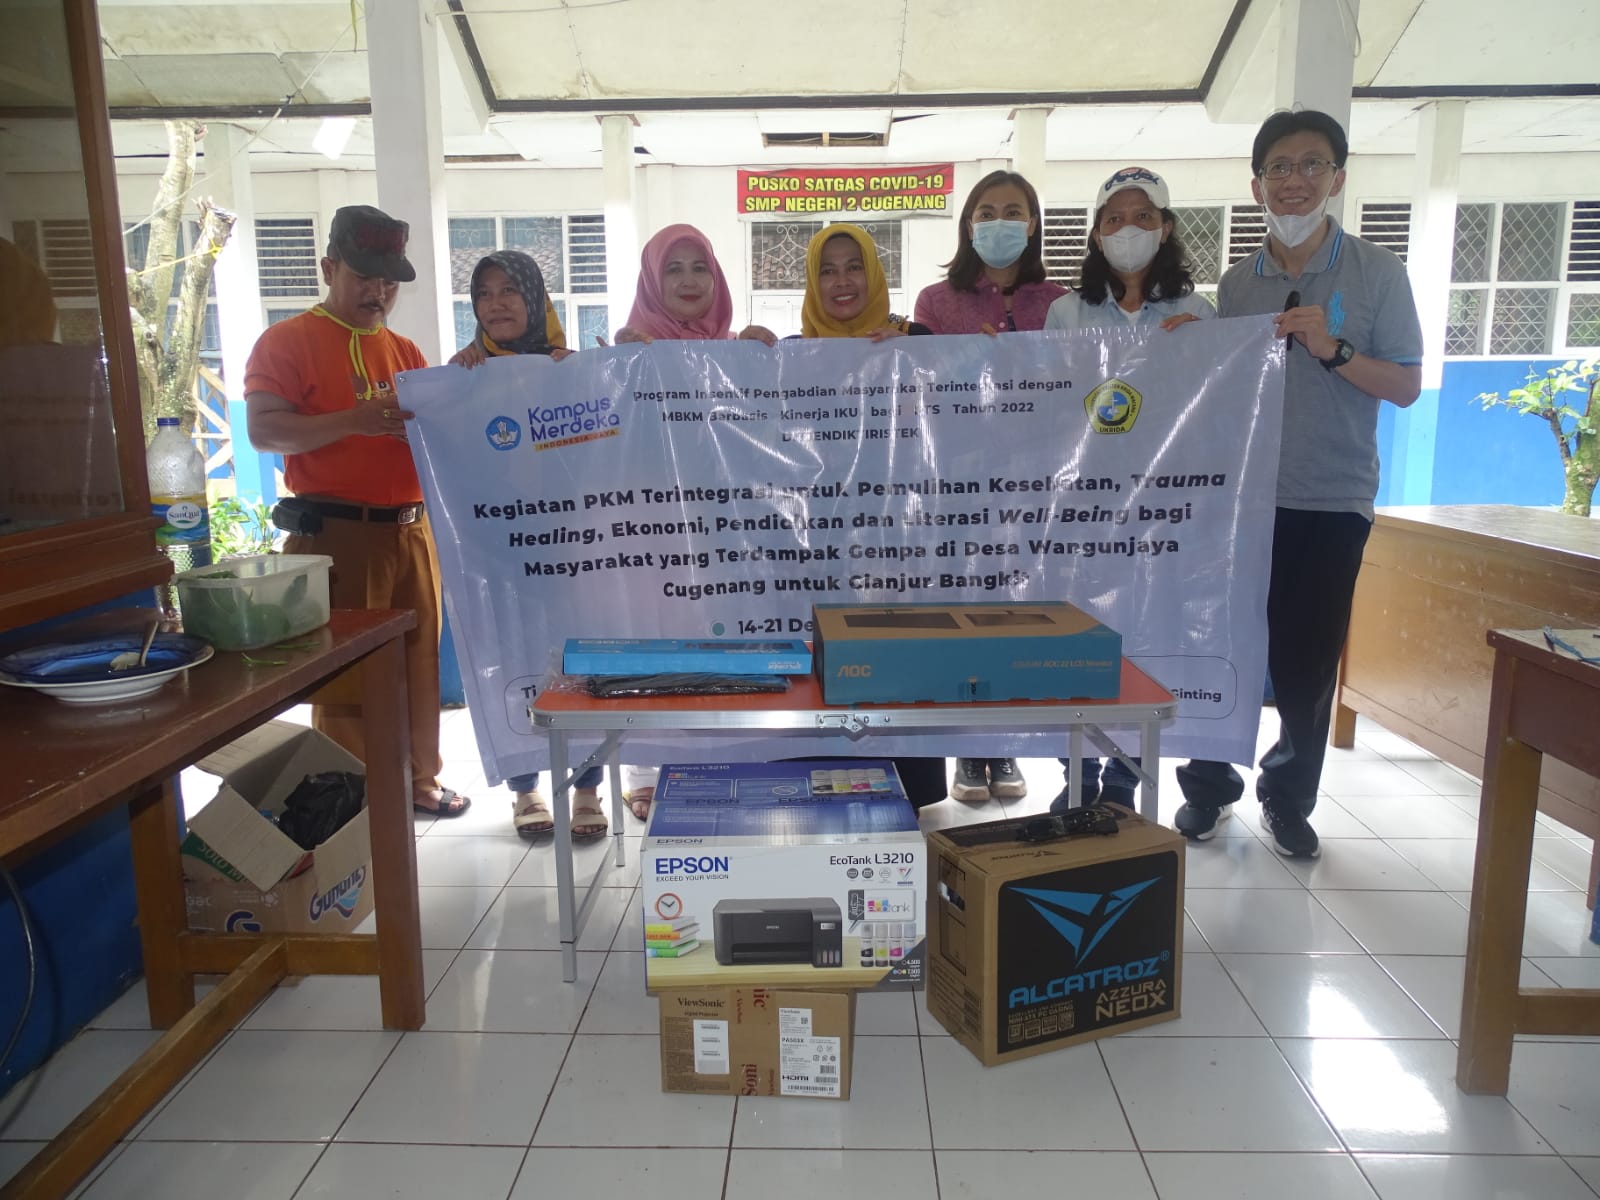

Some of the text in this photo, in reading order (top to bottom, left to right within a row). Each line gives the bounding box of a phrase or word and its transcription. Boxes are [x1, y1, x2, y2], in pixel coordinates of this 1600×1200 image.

[748, 174, 944, 192] POSKO SATGAS COVID-19
[745, 194, 946, 212] SMP NEGERI 2 CUGENANG
[633, 389, 690, 402] Program
[754, 386, 837, 401] Pengabdian
[842, 382, 921, 397] Masyarka
[927, 379, 1013, 392] Terinteasi
[1018, 379, 1072, 392] dengan
[528, 397, 611, 425] Kampus
[662, 411, 703, 422] MBKM
[781, 408, 830, 421] Kinerja
[834, 407, 858, 418] IKU
[952, 403, 997, 415] Tahun
[1001, 402, 1035, 413] 2022
[530, 413, 620, 442] Merdeka
[473, 498, 576, 520] Kegiatan
[583, 489, 635, 509] PKM
[641, 483, 773, 504] Terintegrasi
[858, 478, 980, 496] Pemulihan
[509, 527, 604, 547] Healing,
[611, 516, 710, 538] Ekonomi,
[716, 513, 844, 532] Pendidkan
[852, 512, 894, 528] dan
[999, 505, 1129, 525] Well-Being
[1139, 502, 1192, 524] bagi
[524, 536, 1179, 577] Masyarakat yang Terdampak Gempa di Desa Wangunjaya
[663, 579, 766, 601] Cugenang
[774, 575, 841, 591] untuk
[849, 573, 932, 593] Cianjur
[738, 618, 782, 635] 14-21
[837, 664, 872, 678] AOC
[655, 852, 914, 875] EPSON EcoTank L3210
[1008, 956, 1160, 1009] ALCATROZ
[1096, 978, 1167, 1004] AZZURA
[678, 997, 725, 1008] ViewSonic
[1095, 990, 1167, 1022] NEOX
